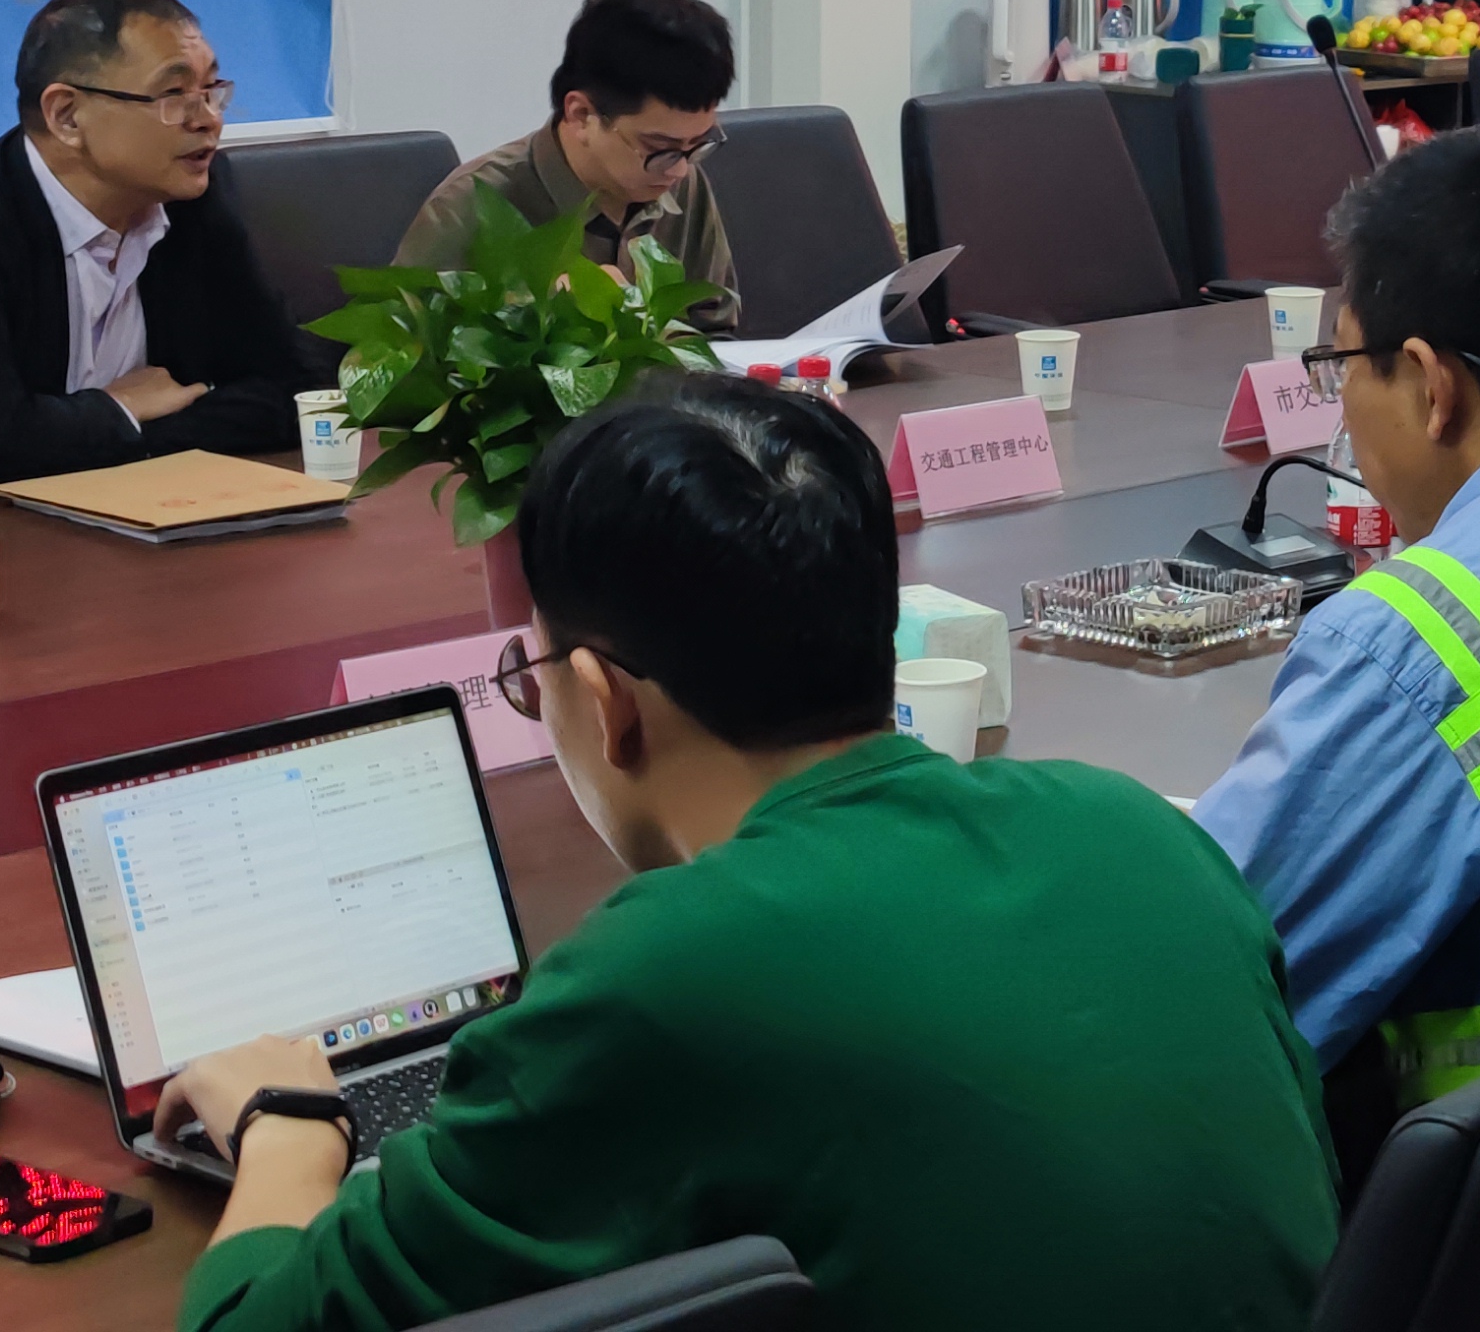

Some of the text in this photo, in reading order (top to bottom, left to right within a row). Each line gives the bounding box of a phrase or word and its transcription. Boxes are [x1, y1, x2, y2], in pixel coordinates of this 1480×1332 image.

[1273, 381, 1338, 414] 市交
[921, 434, 1049, 474] 交通工程管理中心
